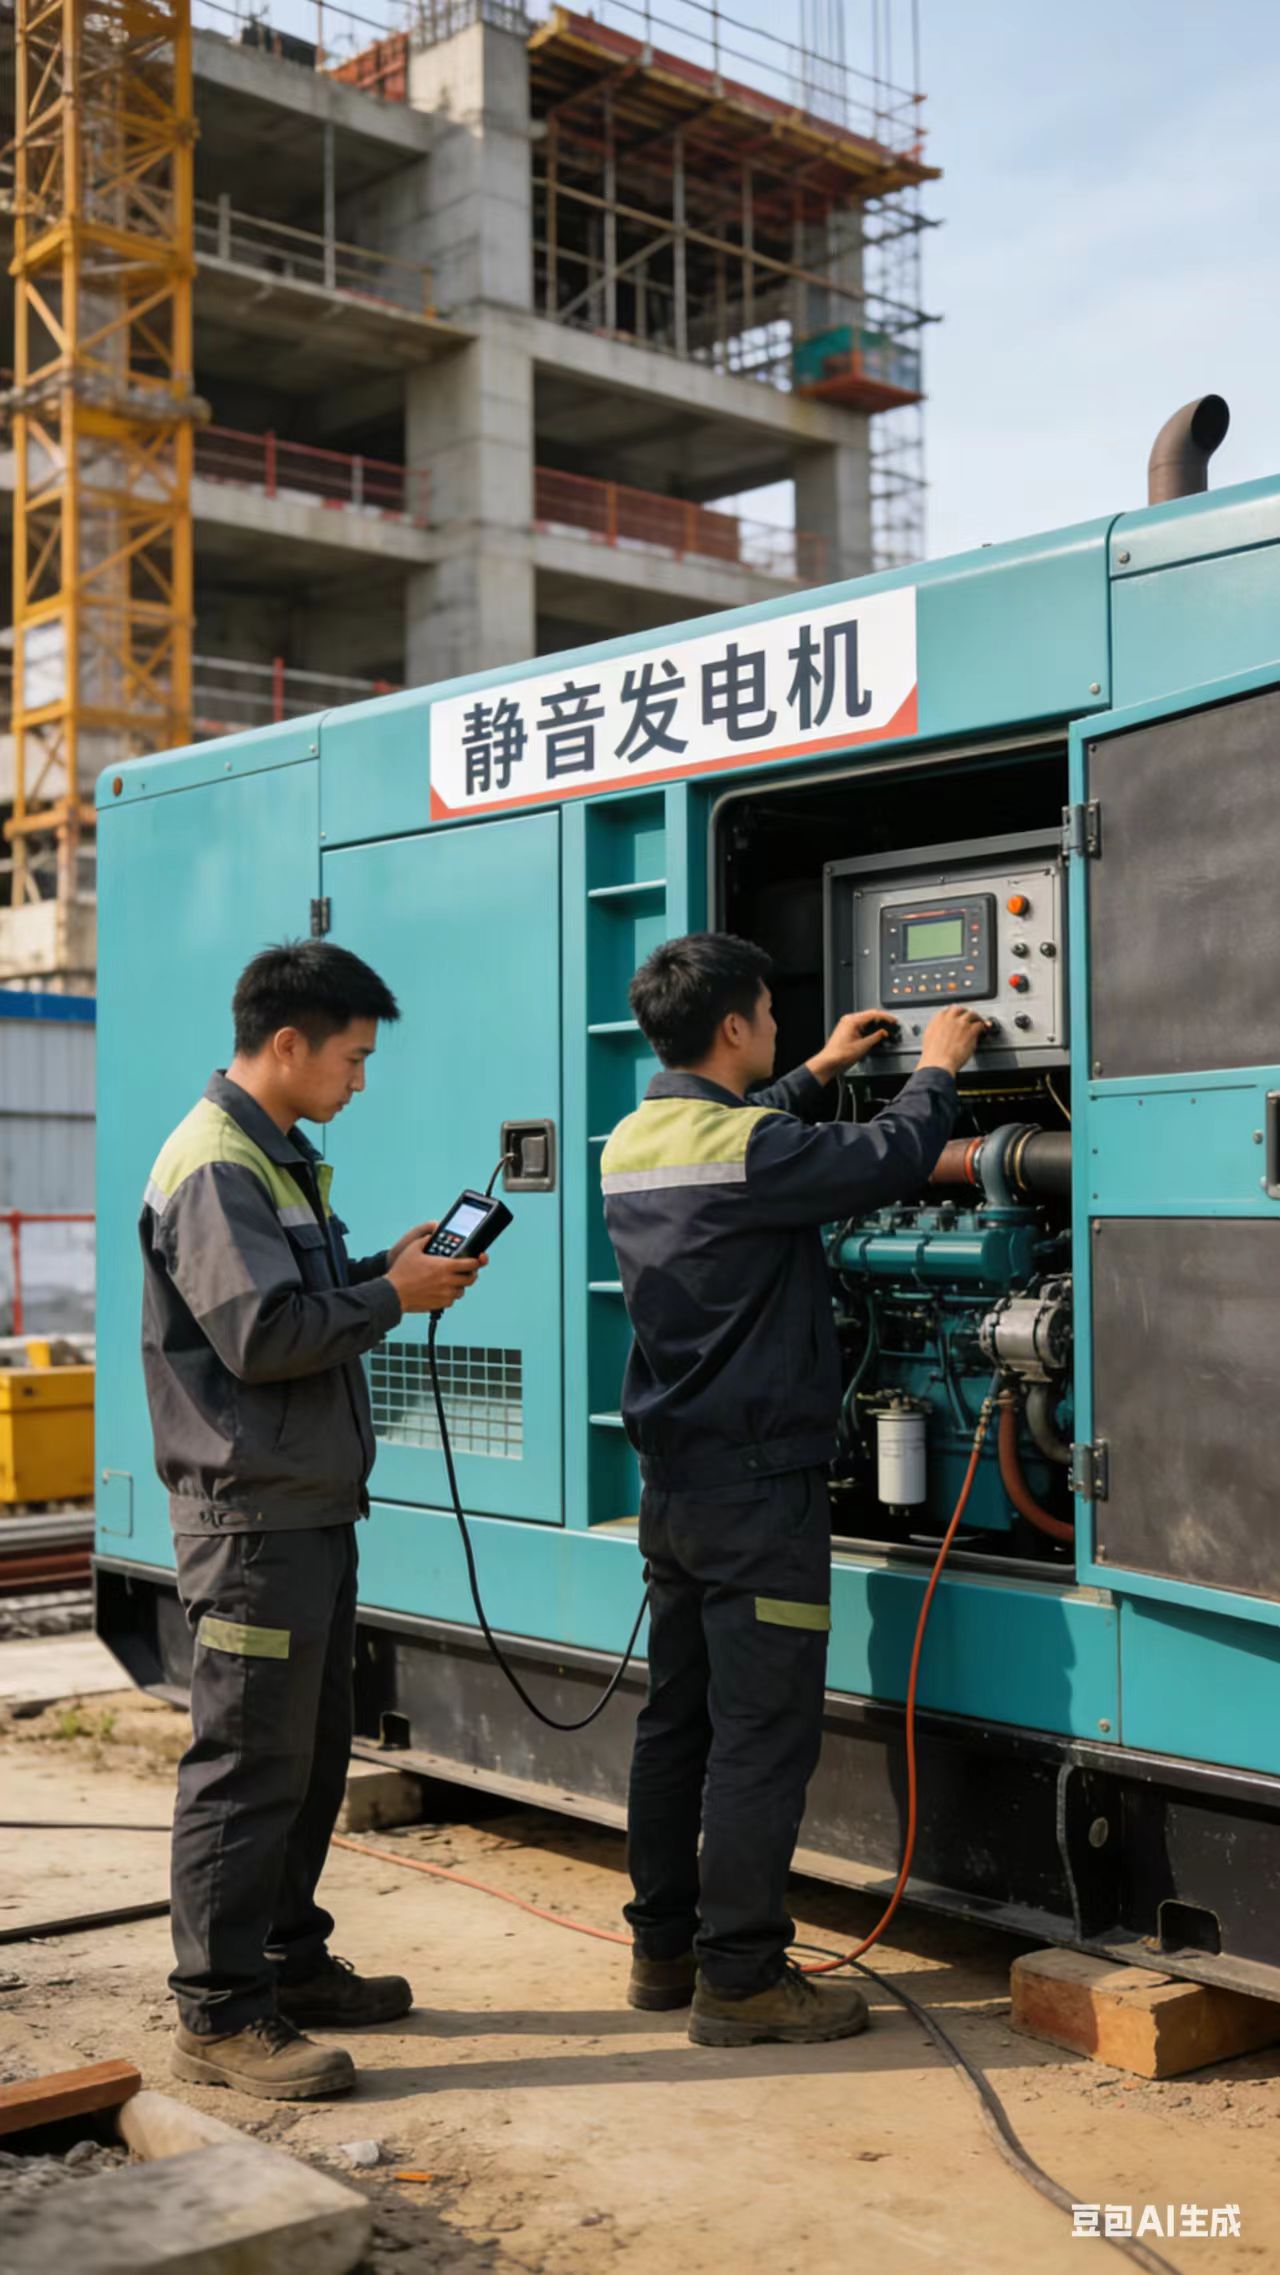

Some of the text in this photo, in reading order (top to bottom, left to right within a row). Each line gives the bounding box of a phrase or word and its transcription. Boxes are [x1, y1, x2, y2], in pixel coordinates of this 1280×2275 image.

[462, 619, 873, 796] 静音发电机
